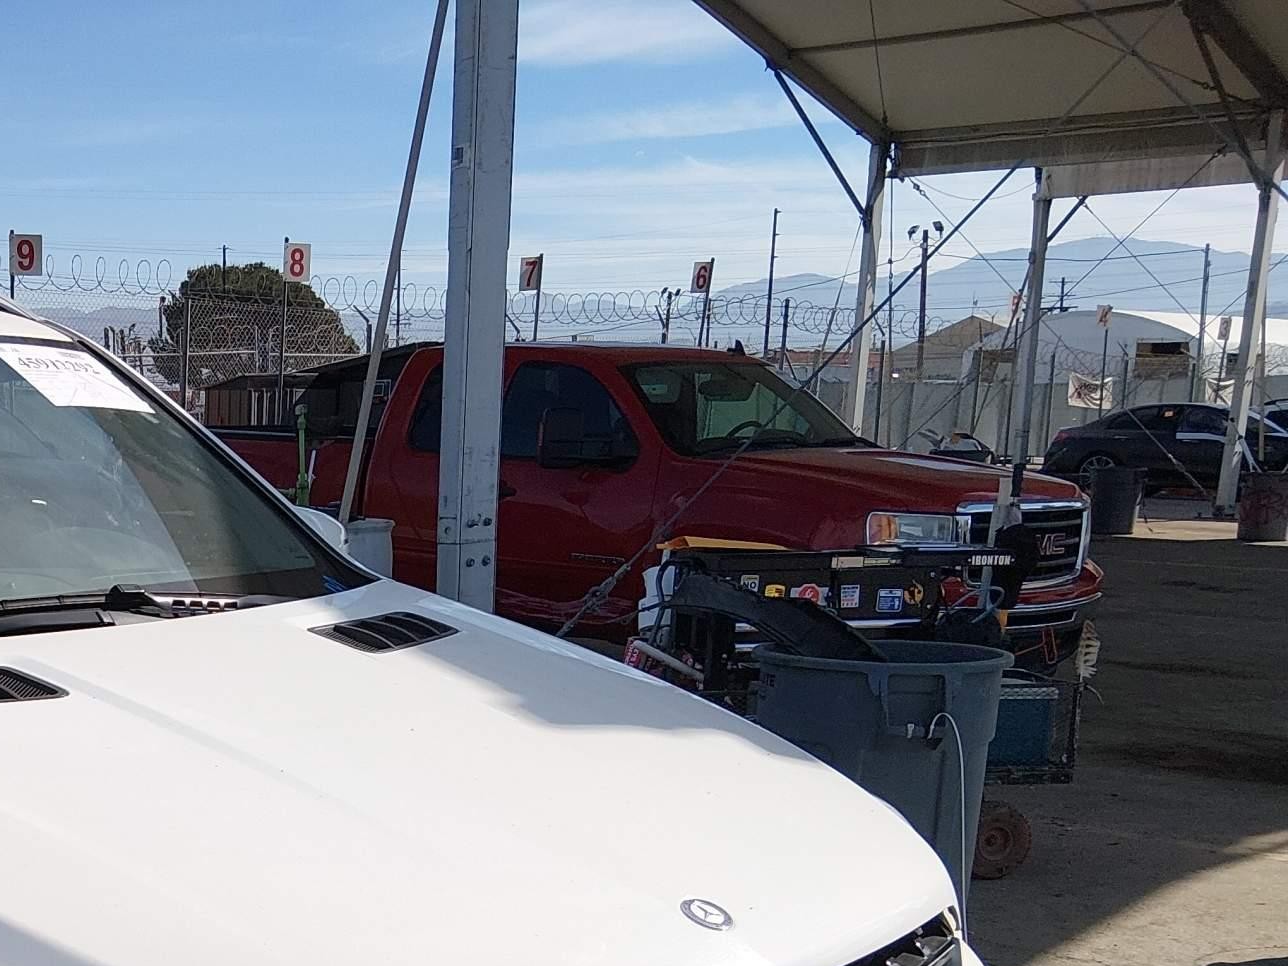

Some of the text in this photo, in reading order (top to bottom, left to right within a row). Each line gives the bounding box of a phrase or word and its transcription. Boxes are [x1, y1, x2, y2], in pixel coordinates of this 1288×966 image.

[16, 239, 35, 271] 9
[289, 247, 305, 278] 8
[525, 260, 538, 288] 7
[695, 265, 708, 290] 6
[1220, 319, 1229, 338] 3
[970, 554, 1012, 566] IRONTON
